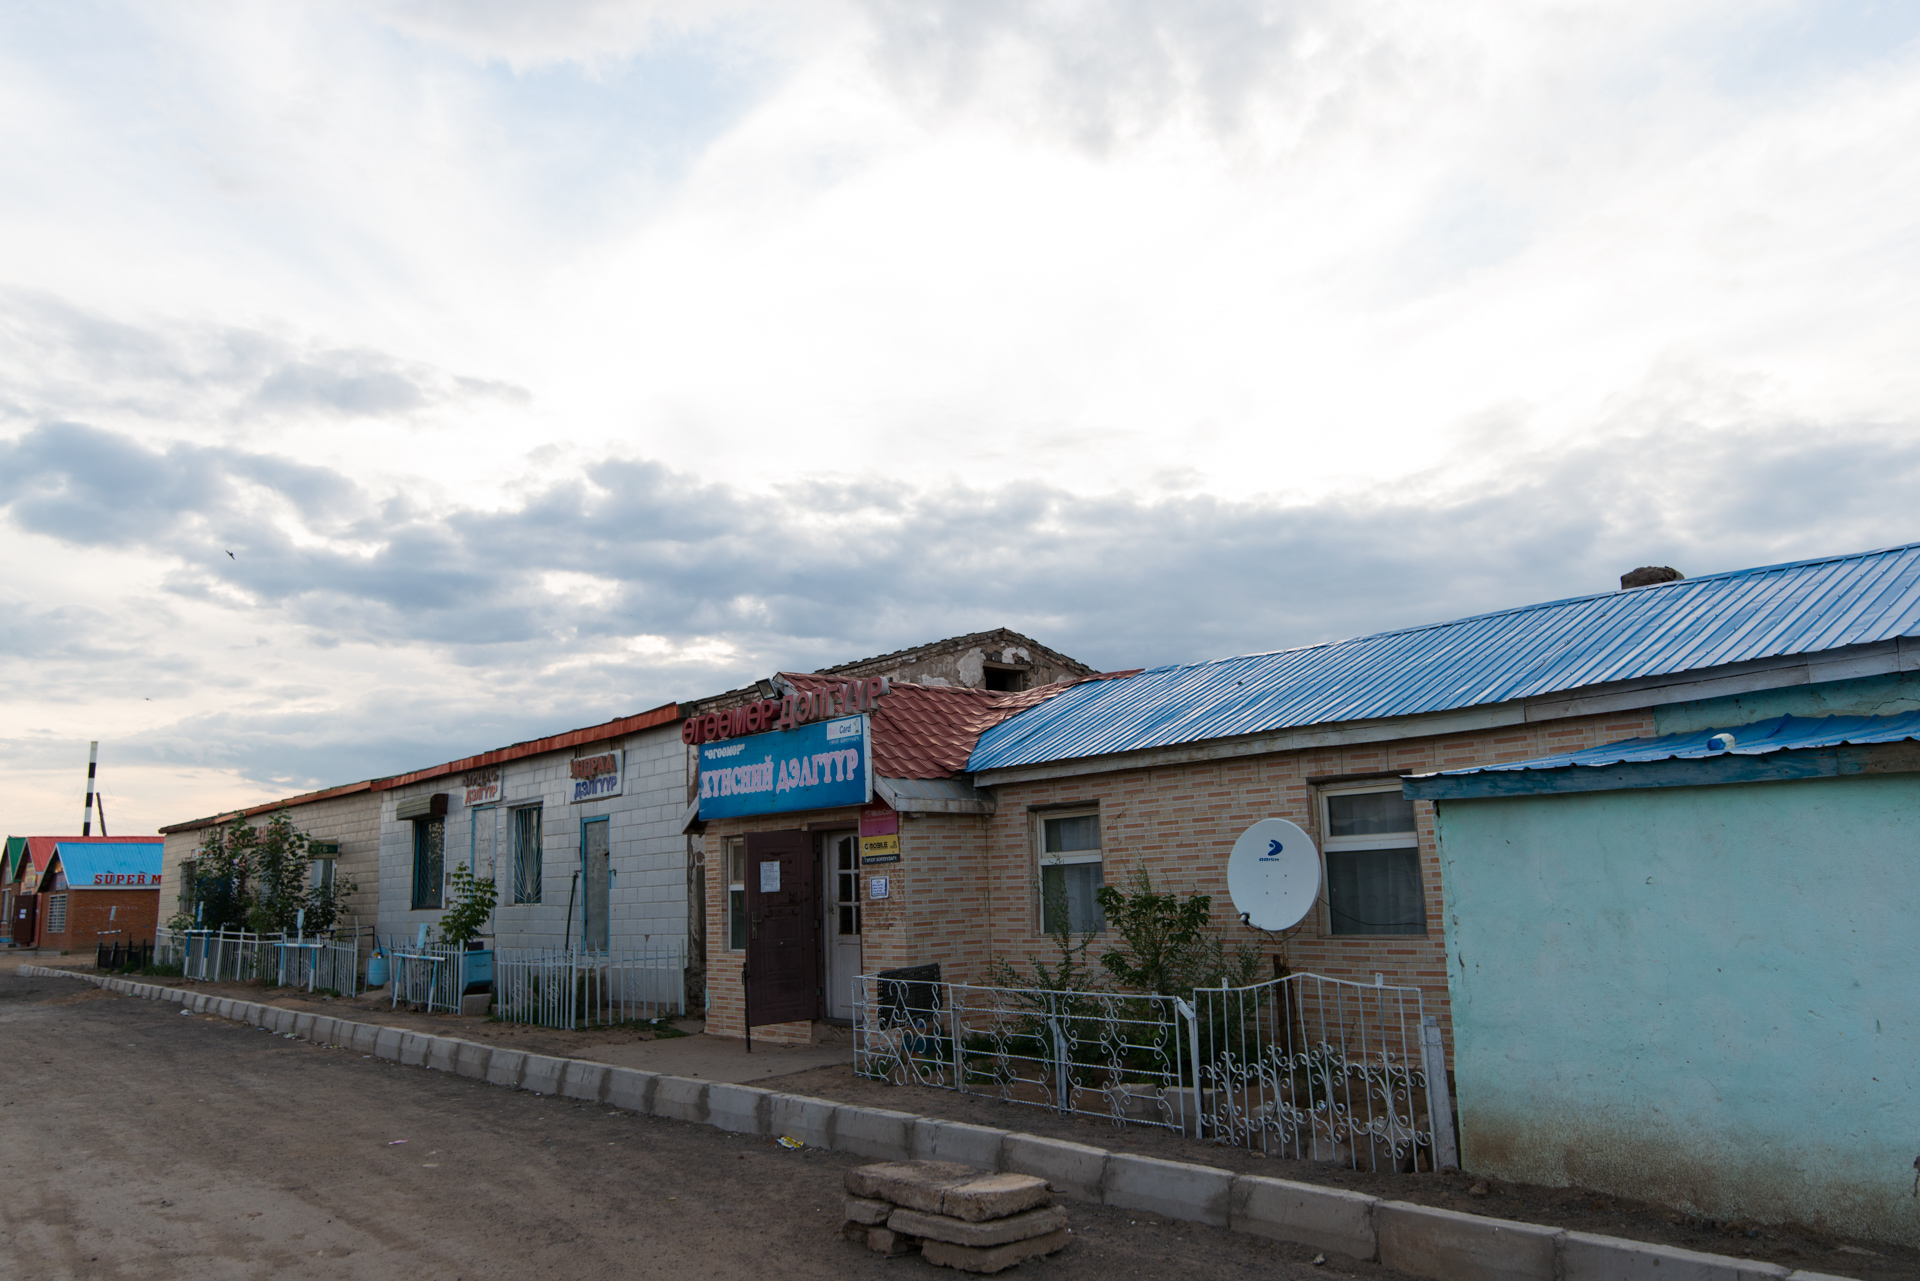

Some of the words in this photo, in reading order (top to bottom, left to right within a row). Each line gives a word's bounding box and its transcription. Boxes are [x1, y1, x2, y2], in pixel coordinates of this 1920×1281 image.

[682, 699, 779, 744] ӨГӨӨМӨР
[778, 677, 884, 731] ДЭЛГҮҮР
[570, 754, 615, 780] УНДРАА
[701, 755, 774, 799] ХҮНСНИЙ
[776, 748, 859, 794] ДЭЛГҮҮР
[464, 784, 498, 805] ДЭЛГҮҮР
[574, 775, 617, 800] ДЭЛГҮҮР
[94, 874, 146, 885] SUPER
